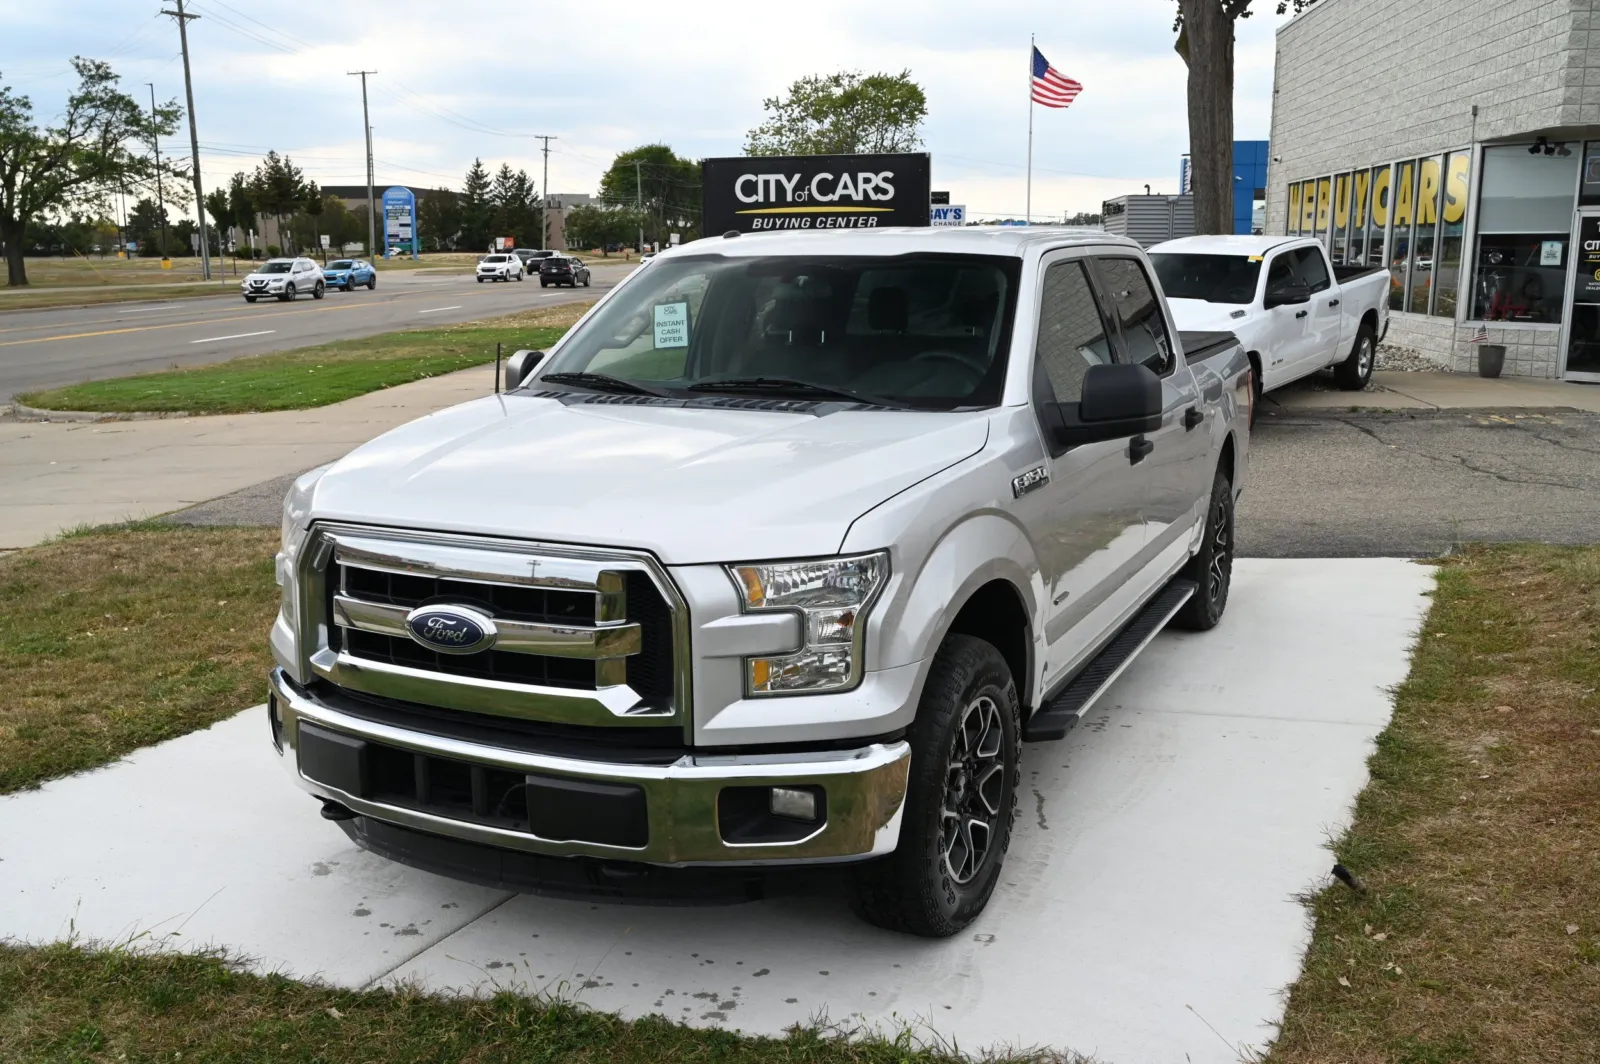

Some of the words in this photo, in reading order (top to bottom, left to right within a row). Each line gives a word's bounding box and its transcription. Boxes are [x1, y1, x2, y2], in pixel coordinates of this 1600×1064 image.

[735, 173, 801, 204] CITY
[794, 185, 811, 202] of
[810, 171, 895, 202] CARS
[752, 217, 811, 229] BUYING
[815, 216, 878, 228] CENTER
[659, 336, 683, 344] OFFER
[423, 617, 468, 642] Ford
